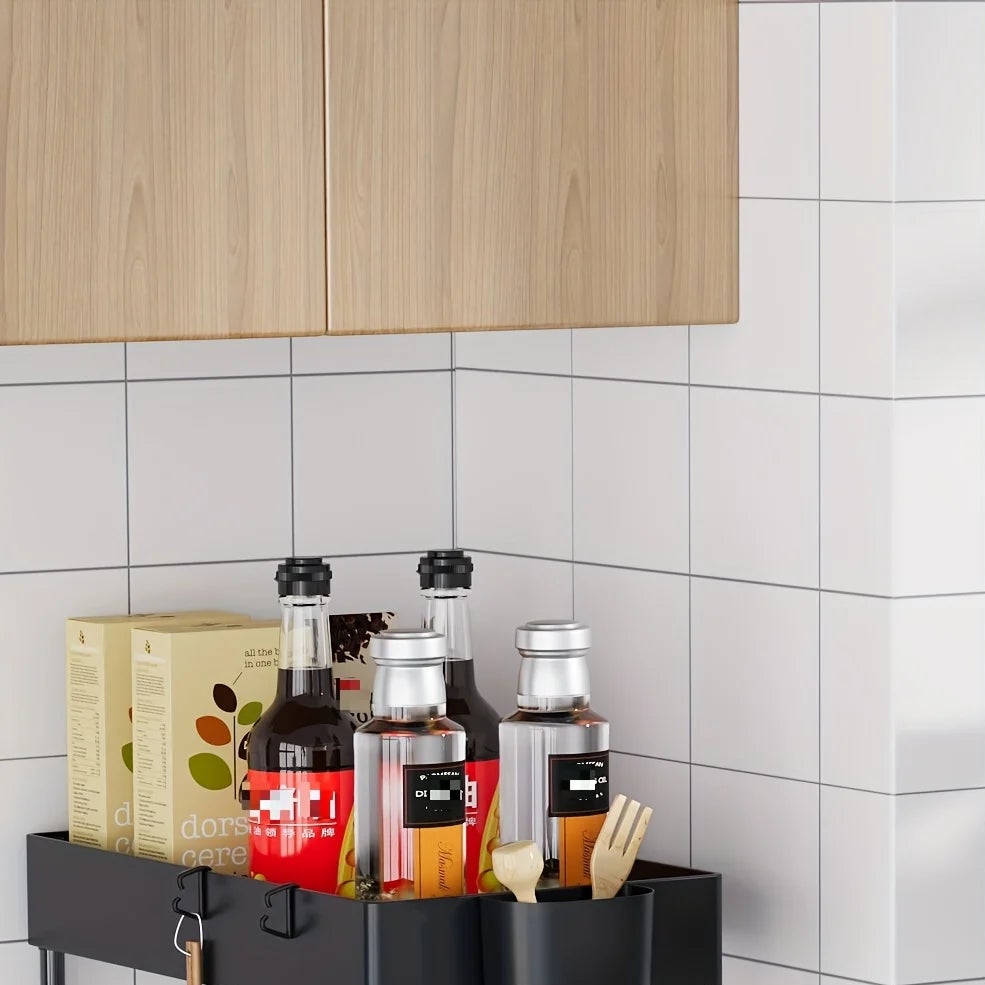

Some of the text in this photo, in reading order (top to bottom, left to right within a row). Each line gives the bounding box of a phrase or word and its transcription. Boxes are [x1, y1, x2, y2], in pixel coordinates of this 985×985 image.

[244, 648, 256, 657] all
[258, 648, 272, 657] the
[244, 660, 254, 669] in
[256, 660, 272, 668] one
